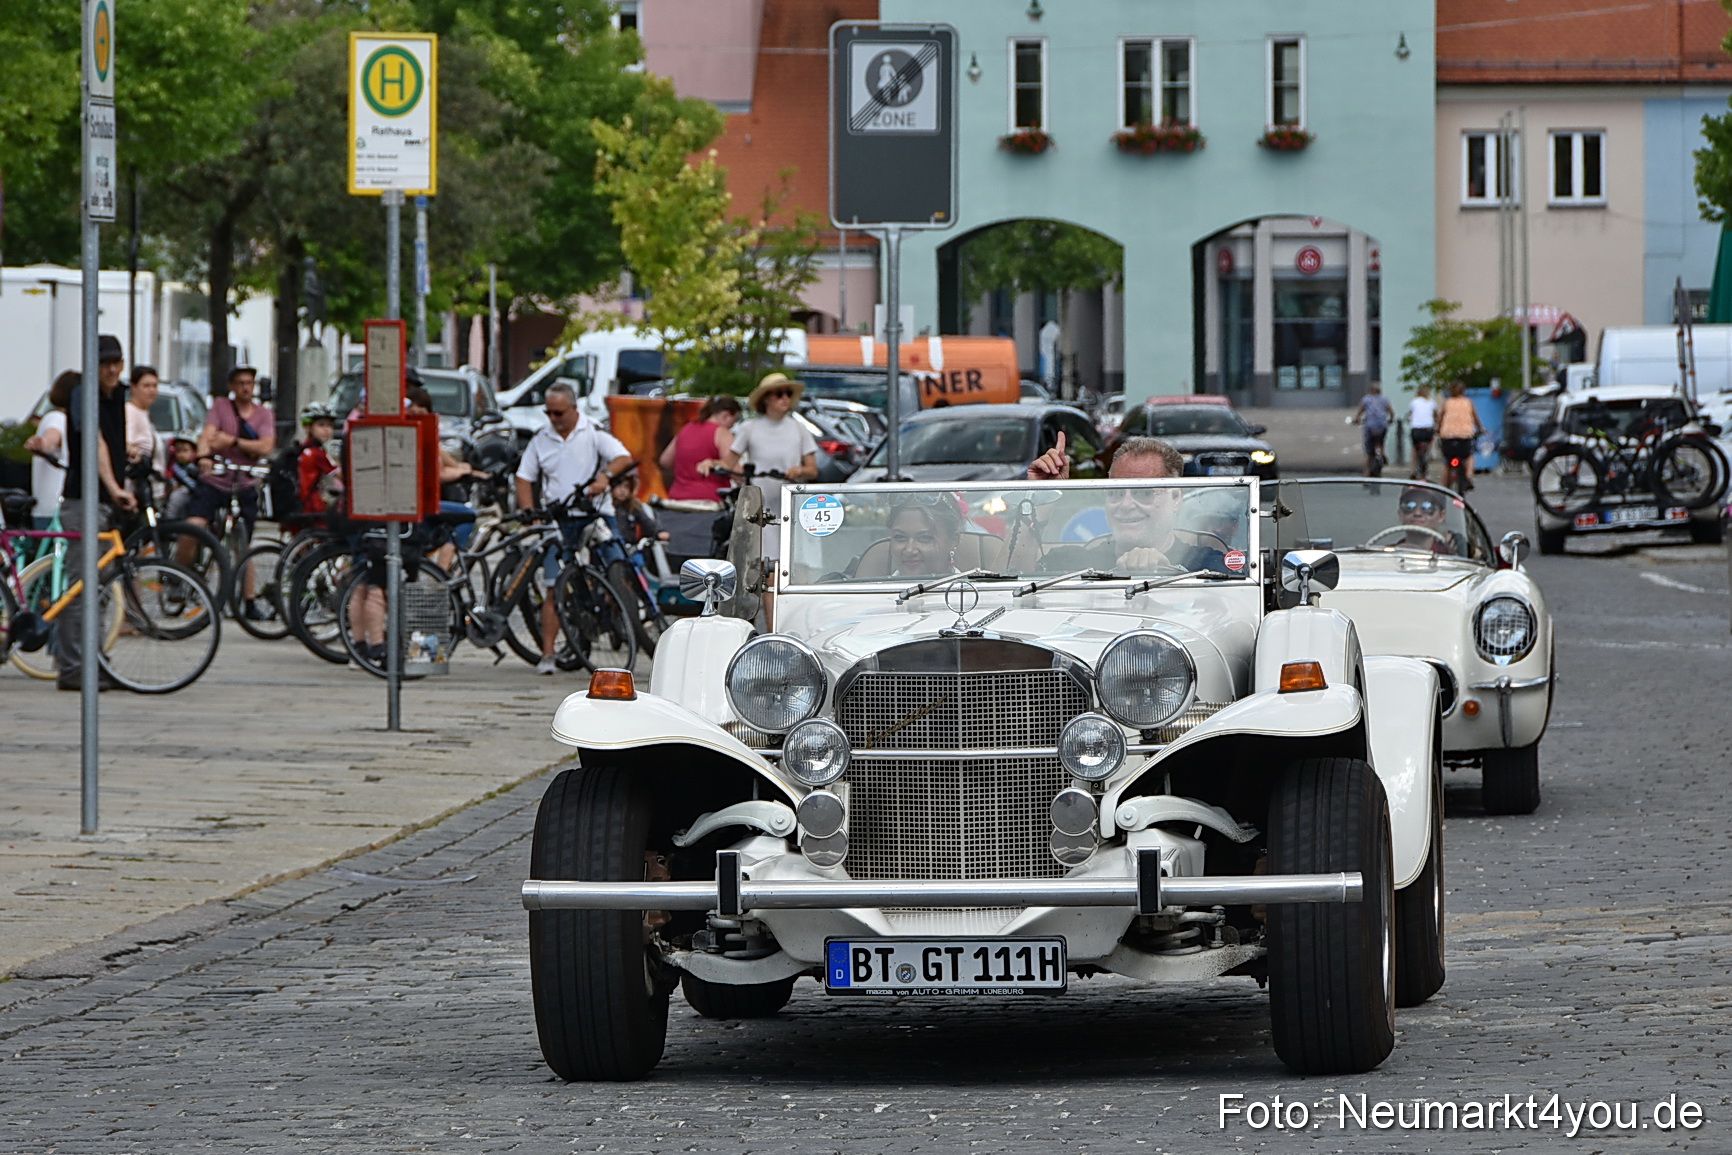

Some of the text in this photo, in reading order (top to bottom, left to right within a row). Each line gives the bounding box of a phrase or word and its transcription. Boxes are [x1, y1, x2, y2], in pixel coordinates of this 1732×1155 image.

[380, 61, 405, 101] H
[371, 125, 413, 136] Rathaus
[814, 510, 831, 523] 45
[852, 945, 1060, 983] BT GT 111H
